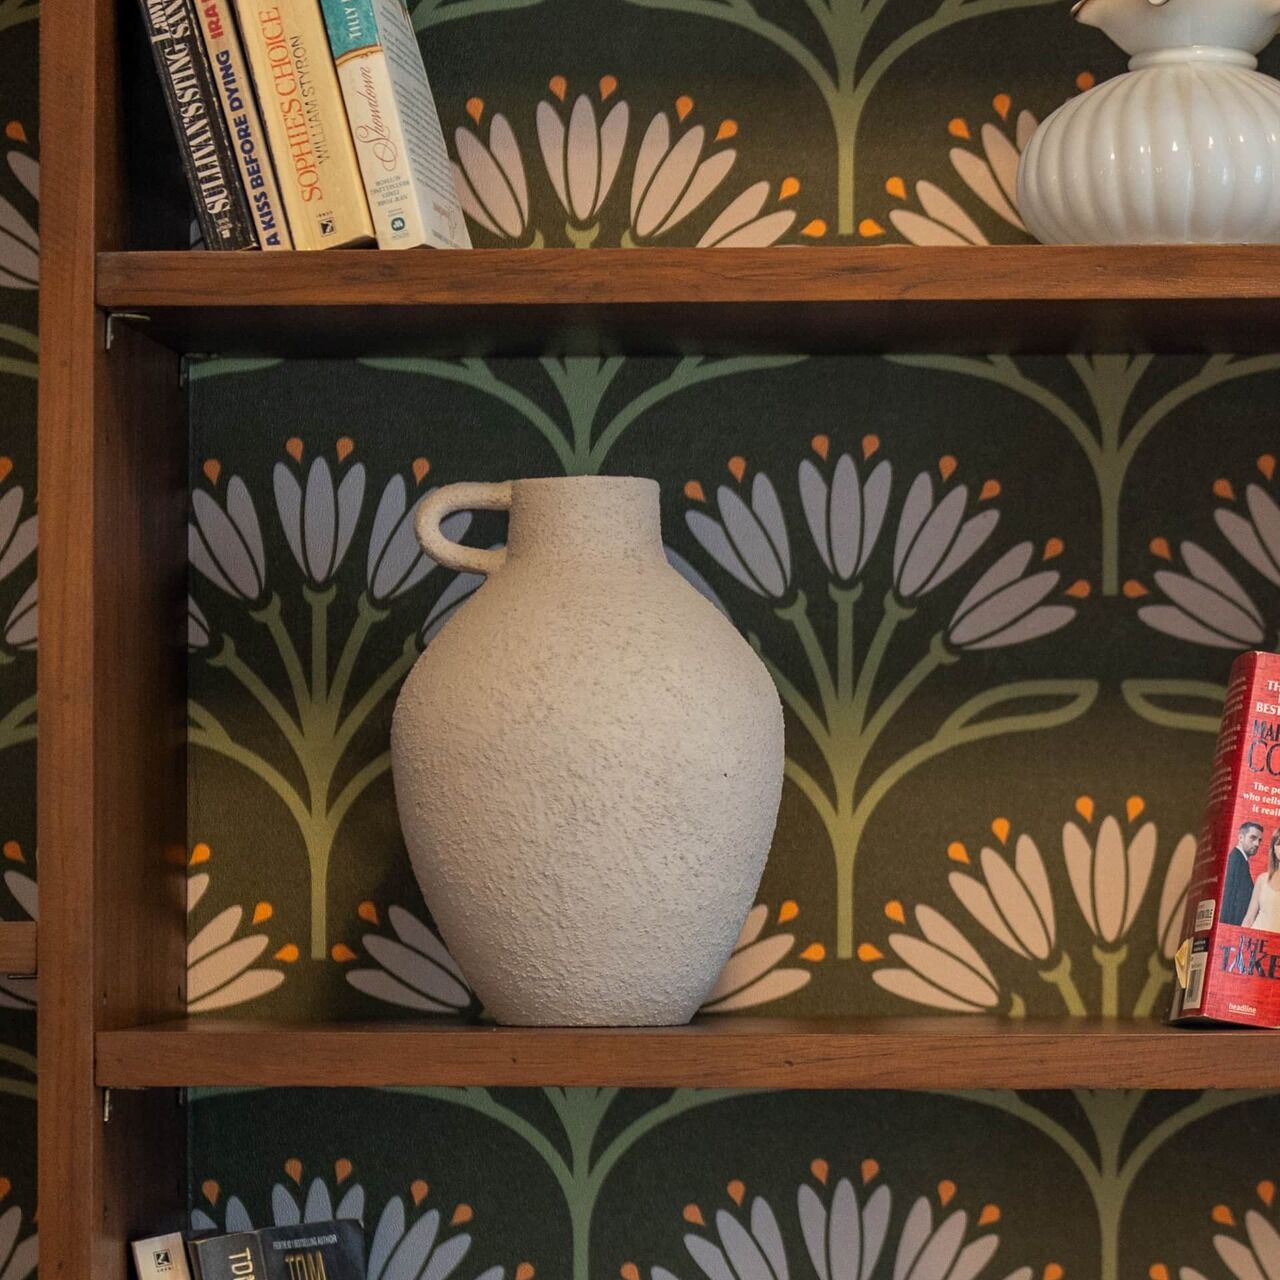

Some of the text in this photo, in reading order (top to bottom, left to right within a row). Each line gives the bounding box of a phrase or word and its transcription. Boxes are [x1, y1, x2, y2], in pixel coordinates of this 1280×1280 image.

[204, 4, 224, 40] IRA
[344, 7, 362, 40] TILLY
[259, 7, 324, 202] SOPHIE'S CHOICE
[289, 35, 331, 166] WILLIAM STYRON
[164, 42, 231, 214] SULLIVAN'S STING
[355, 66, 398, 171] Showdown
[216, 50, 281, 246] A KISS BEFORE DYING
[1243, 791, 1261, 802] who
[1252, 781, 1270, 792] The
[1252, 803, 1260, 813] it
[1239, 935, 1269, 954] THE
[1228, 1001, 1257, 1014] headline
